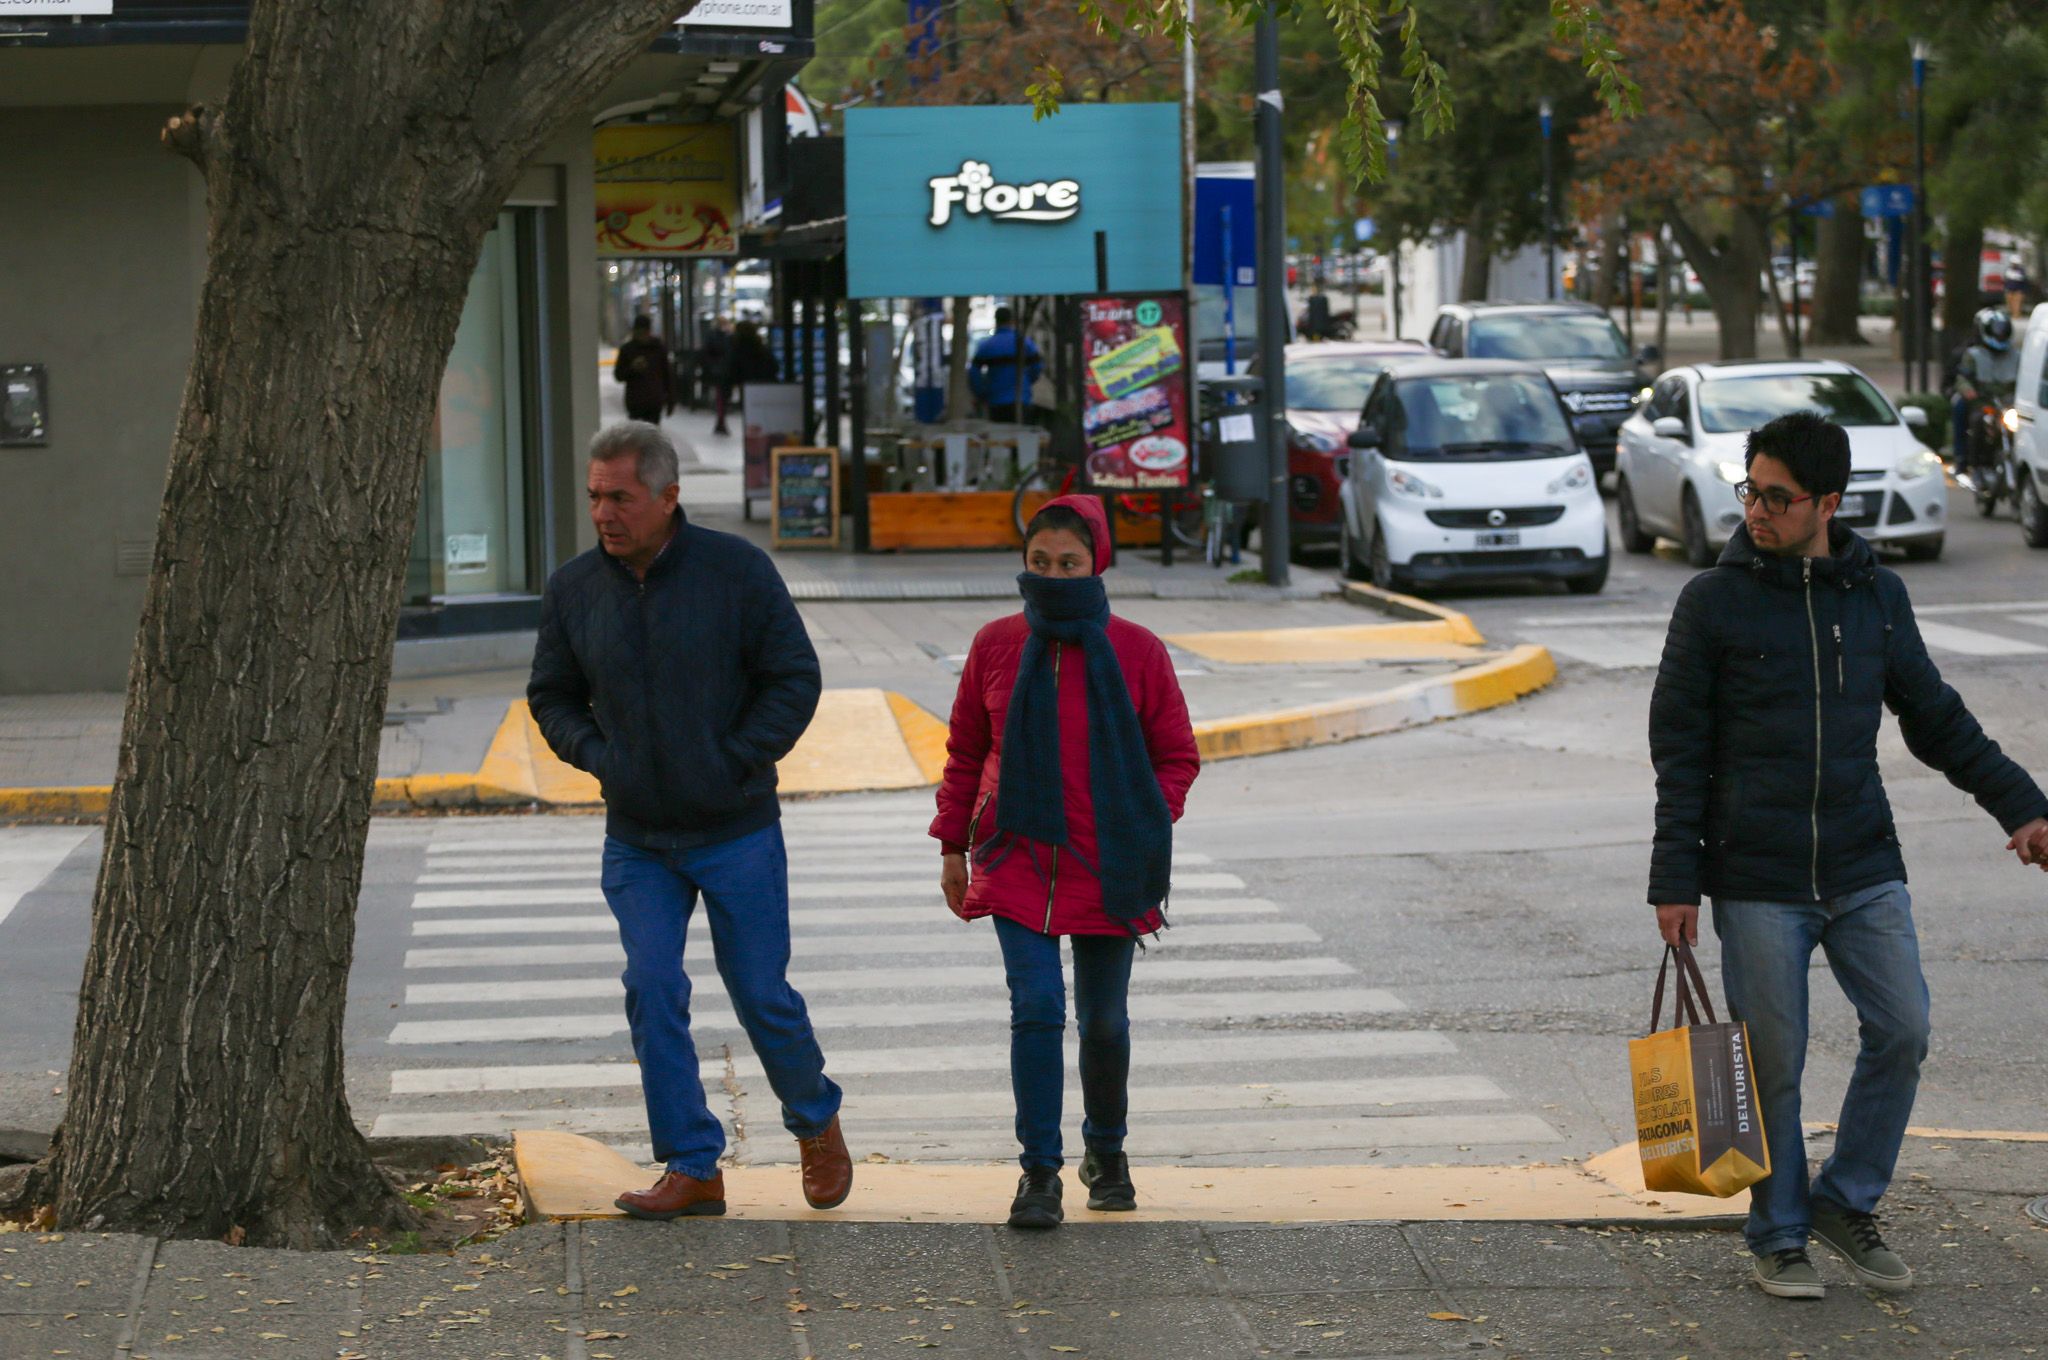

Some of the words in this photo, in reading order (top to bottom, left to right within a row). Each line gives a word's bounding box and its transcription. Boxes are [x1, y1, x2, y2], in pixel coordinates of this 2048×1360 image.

[929, 160, 1080, 226] Fiore
[1731, 1032, 1750, 1133] DELTURISTA
[1638, 1118, 1693, 1142] PATAGONIA
